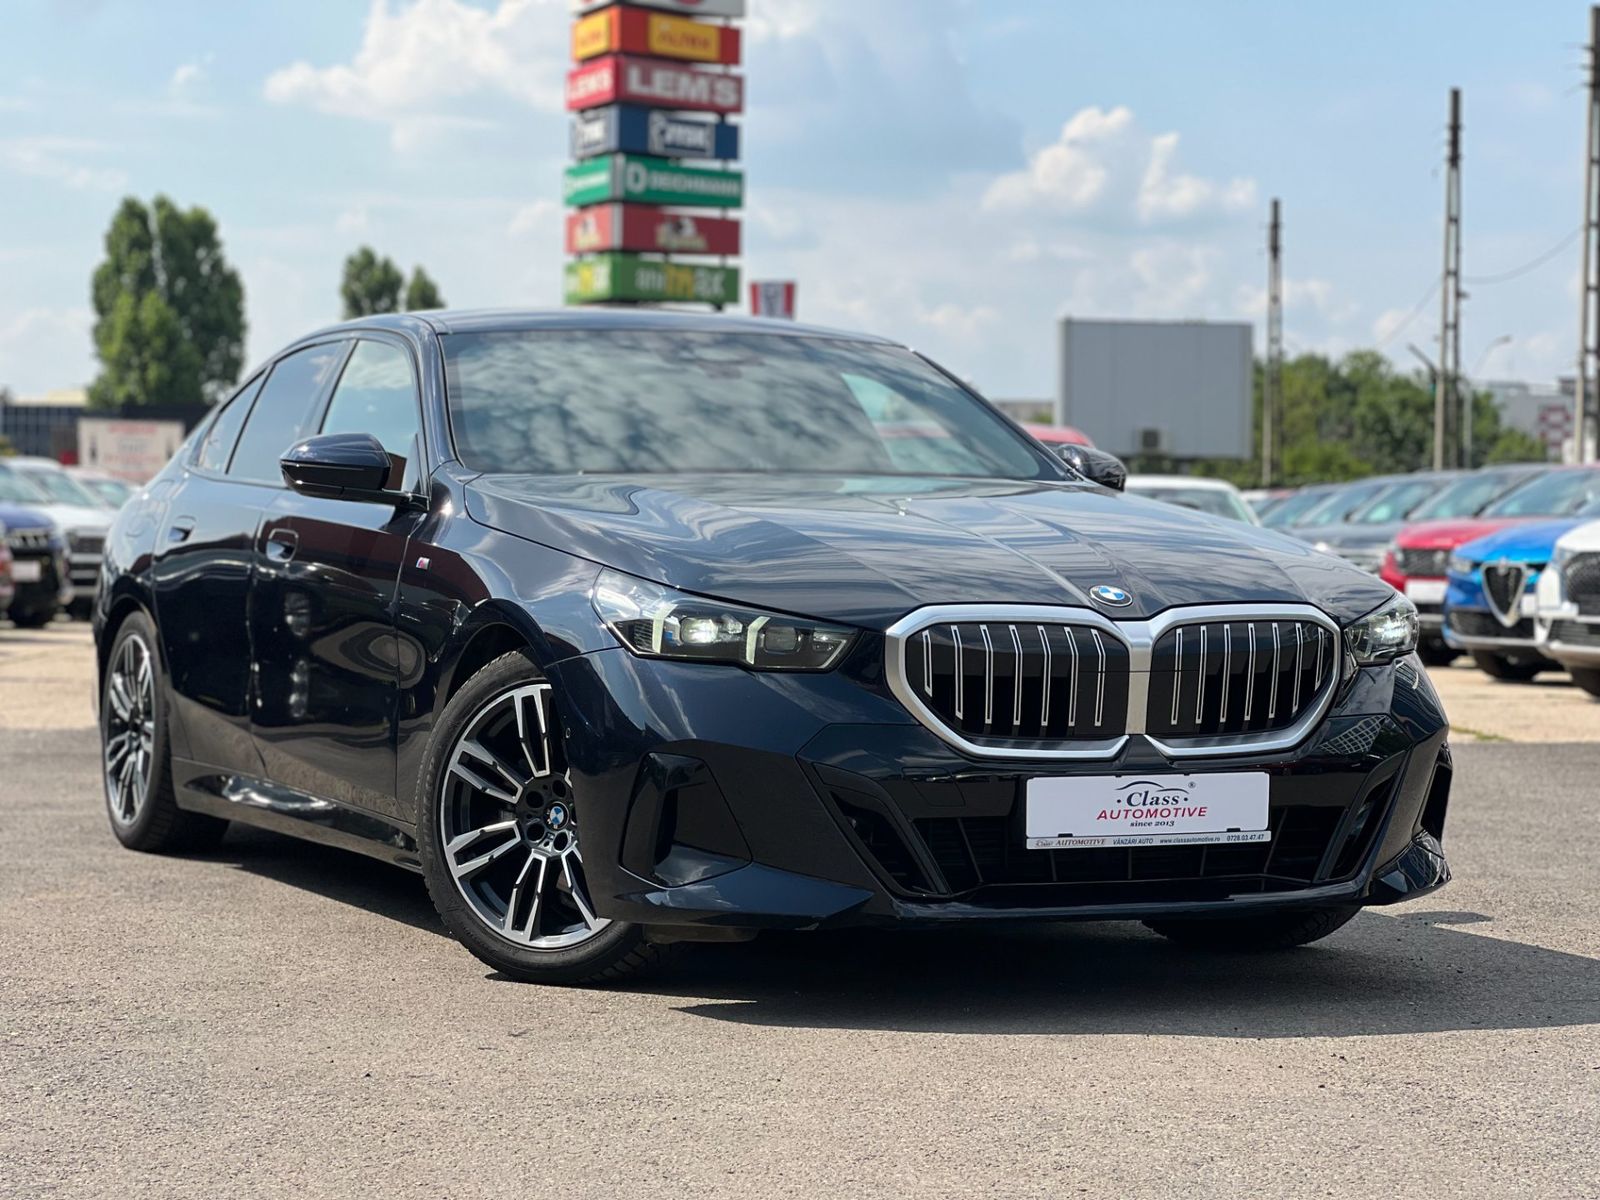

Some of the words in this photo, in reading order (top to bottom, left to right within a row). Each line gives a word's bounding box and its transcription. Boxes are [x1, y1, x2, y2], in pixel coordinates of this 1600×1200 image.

[1126, 790, 1180, 807] Class
[1096, 806, 1208, 821] AUTOMOTIVE
[1129, 820, 1153, 828] since
[1154, 820, 1175, 828] 2013
[1056, 838, 1106, 847] AUTOMOTIVE
[1138, 836, 1153, 845] AUTO
[1160, 836, 1221, 844] www.classautomotive.ro
